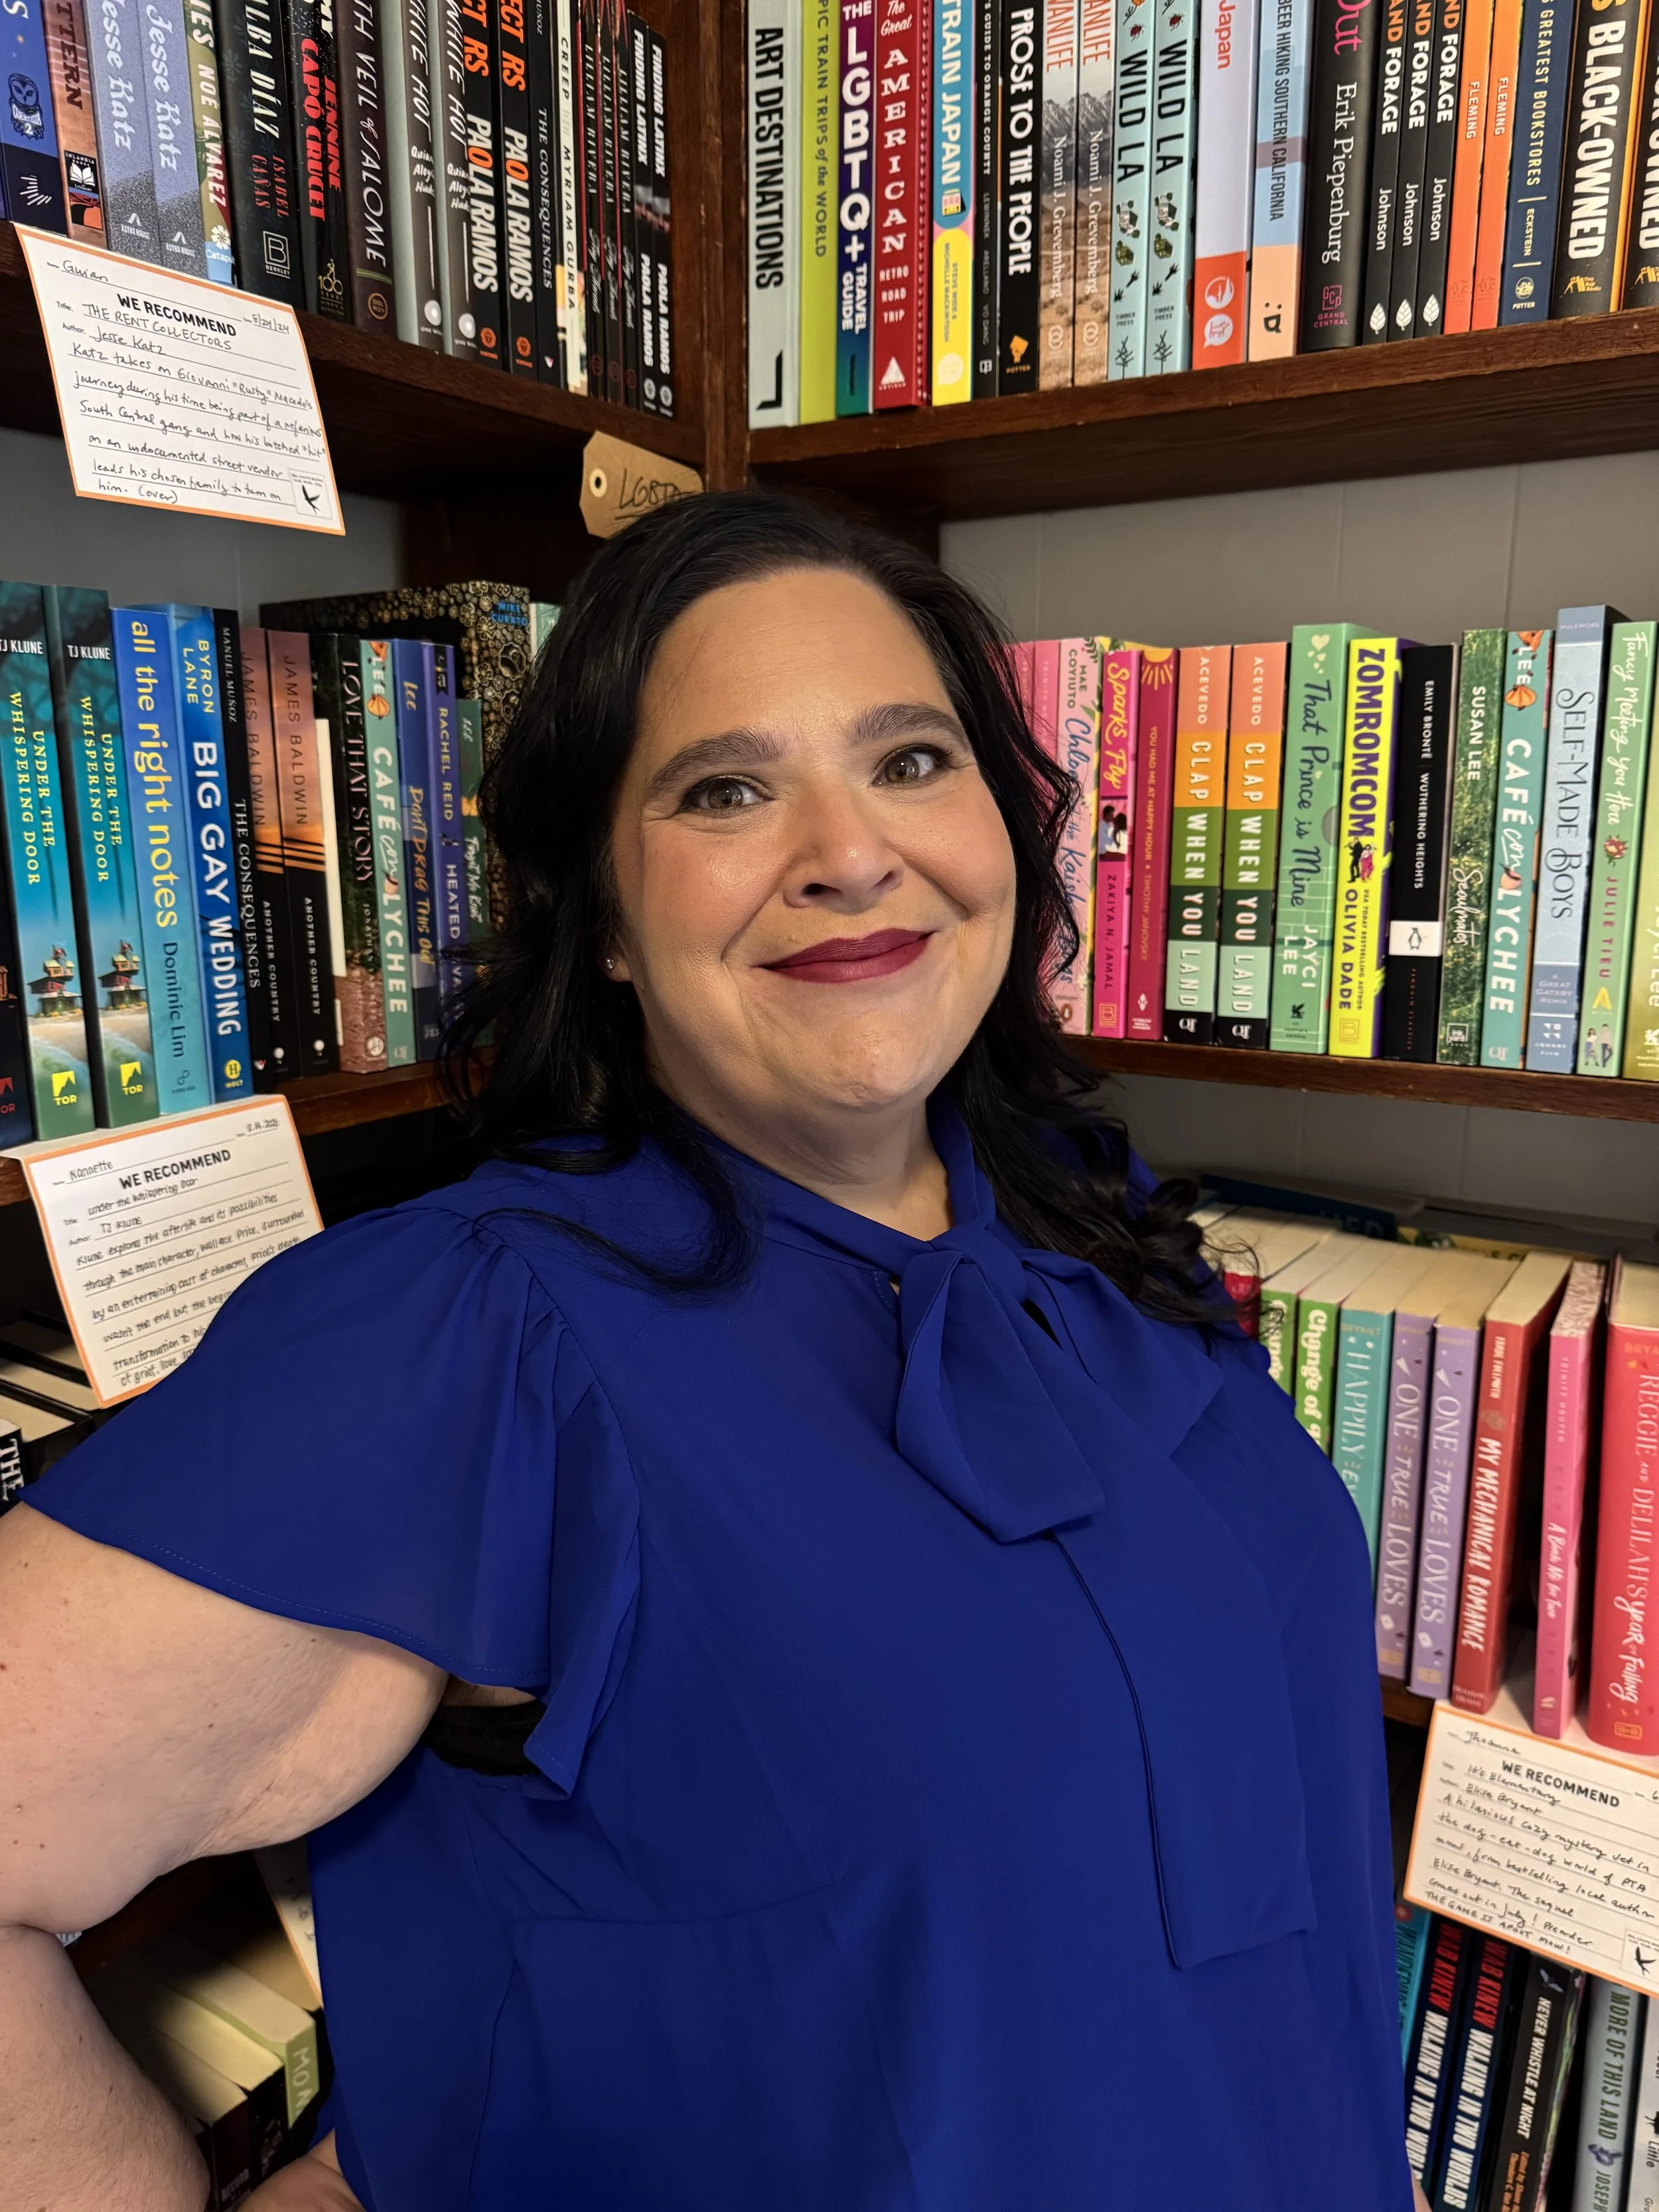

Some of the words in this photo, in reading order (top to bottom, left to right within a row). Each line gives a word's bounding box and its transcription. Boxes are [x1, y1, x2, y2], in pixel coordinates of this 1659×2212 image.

[842, 3, 872, 19] THE
[881, 15, 912, 37] Great
[146, 3, 173, 93] Jesse
[561, 37, 571, 100] CREEP
[634, 29, 645, 94] FINDING
[755, 27, 784, 80] ART
[814, 35, 829, 89] TRAIN
[941, 0, 962, 85] TRAIN
[983, 54, 991, 70] TO
[1010, 7, 1034, 96] PROSE
[1274, 35, 1291, 78] HIKING
[1536, 9, 1554, 85] GREATEST
[1116, 48, 1149, 129] WILD
[1273, 76, 1290, 144] SOUTHERN
[1334, 82, 1357, 131] Erik
[1382, 46, 1402, 135] FORAGE
[1465, 80, 1480, 140] FLEMING
[155, 100, 182, 172] Katz
[324, 75, 342, 192] JENNINE
[538, 108, 547, 145] THE
[635, 101, 648, 166] LATINX
[815, 94, 829, 145] TRIPS
[941, 92, 962, 185] JAPAN
[982, 119, 991, 177] COUNTY
[1010, 101, 1033, 140] TO
[1526, 90, 1548, 186] BOOKSTORES
[1567, 20, 1626, 259] BLACK-OWNED
[816, 165, 828, 186] the
[817, 149, 830, 162] of
[1009, 145, 1033, 186] THE
[1116, 141, 1145, 184] LA
[1269, 145, 1288, 222] CALIFORNIA
[273, 155, 289, 218] ISABEL
[563, 145, 574, 231] MYRIAM
[754, 86, 784, 291] DESTINATIONS
[1321, 137, 1354, 265] Piepenburg
[540, 148, 553, 289] CONSEQUENCES
[815, 192, 827, 259] WORLD
[1008, 193, 1033, 276] PEOPLE
[1376, 187, 1392, 252] Johnson
[1524, 207, 1535, 256] ECKSTEIN
[265, 264, 291, 278] BERKLEY
[566, 242, 576, 309] GURBA
[855, 263, 867, 335] TRAVEL
[879, 265, 909, 282] RETRO
[881, 288, 906, 302] ROAD
[56, 301, 74, 311] Title:
[82, 303, 109, 319] THE
[115, 311, 149, 329] RENT
[153, 321, 232, 350] COLLECTORS
[117, 293, 141, 311] WE
[147, 302, 237, 336] RECOMMEND
[841, 271, 856, 331] GUIDE
[883, 309, 905, 324] TRIP
[1313, 319, 1348, 329] CENTRAL
[1318, 311, 1345, 321] GRAND
[11, 640, 44, 655] KLUNE
[67, 645, 80, 657] TJ
[80, 646, 110, 660] KLUNE
[131, 621, 156, 654] all
[222, 626, 234, 677] MANUEL
[1613, 632, 1648, 682] Fancy
[135, 665, 159, 711] the
[182, 647, 199, 705] LANE
[197, 639, 215, 713] BYRON
[226, 680, 238, 723] MUÑOZ
[242, 652, 258, 721] JAMES
[1068, 648, 1077, 710] COYIUTO
[1079, 664, 1088, 692] MAE
[1104, 662, 1131, 745] Sparks
[1198, 657, 1211, 725] ACEVEDO
[1304, 679, 1332, 732] That
[1424, 680, 1435, 707] EMILY
[438, 707, 451, 774] RACHEL
[1348, 648, 1386, 838] ZOMROMCOM
[1469, 686, 1486, 746] SUSAN
[1610, 687, 1644, 755] Meeting
[9, 691, 33, 823] WHISPERING
[23, 831, 40, 885] DOOR
[32, 730, 50, 798] UNDER
[135, 723, 173, 814] right
[192, 741, 222, 810] BIG
[247, 733, 266, 826] BALDWIN
[373, 747, 401, 831] CAFÉ
[1103, 749, 1126, 790] Fly
[1189, 741, 1212, 800] CLAP
[1297, 745, 1329, 811] Prince
[1467, 753, 1481, 782] LEE
[1555, 688, 1595, 838] SELF-MADE
[1607, 757, 1631, 787] You
[40, 806, 55, 848] THE
[441, 782, 453, 821] REID
[1295, 816, 1310, 840] is
[1415, 772, 1429, 841] WUTHERING
[1606, 792, 1633, 825] Here
[201, 823, 231, 904] GAY
[1185, 813, 1206, 879] WHEN
[1414, 843, 1424, 890] HEIGHTS
[148, 824, 180, 928] notes
[445, 864, 460, 940] HEATED
[1291, 846, 1322, 907] Mine
[1545, 847, 1582, 920] BOYS
[1602, 877, 1618, 928] JULIE
[264, 900, 276, 960] ANOTHER
[1181, 891, 1204, 936] YOU
[1340, 889, 1358, 956] OLIVIA
[1450, 868, 1483, 947] Seoulmates
[163, 942, 182, 1021] Dominic
[209, 915, 242, 1037] WEDDING
[382, 895, 408, 1013] LYCHEE
[1178, 948, 1200, 1007] LAND
[1283, 936, 1297, 976] LEE
[1302, 924, 1319, 988] JAYCI
[1598, 938, 1613, 979] TIEU
[267, 964, 280, 1023] COUNTRY
[1338, 962, 1354, 1010] DADE
[170, 1025, 186, 1058] Lim
[54, 1095, 77, 1106] TOR
[123, 1084, 143, 1095] TOR
[119, 1175, 141, 1189] WE
[143, 1149, 232, 1183] RECOMMEND
[1301, 1309, 1327, 1391] Change
[1303, 1395, 1322, 1420] of
[1392, 1382, 1421, 1439] ONE
[1478, 1436, 1502, 1469] MY
[1390, 1457, 1412, 1516] TRUE
[1467, 1471, 1500, 1570] MECHANICAL
[1381, 1523, 1412, 1609] LOVES
[1461, 1572, 1492, 1653] ROMANCE
[1502, 1759, 1522, 1776] WE
[1526, 1768, 1620, 1808] RECOMMEND
[1534, 1996, 1551, 2033] NEVER
[1609, 1991, 1631, 2036] MORE
[1417, 2010, 1449, 2079] WALKING
[1461, 2028, 1493, 2098] WALKING
[1526, 2035, 1546, 2087] WHISTLE
[1607, 2037, 1625, 2059] OF
[1413, 2075, 1437, 2099] IN
[1523, 2085, 1538, 2102] AT
[1602, 2055, 1624, 2096] THIS
[1409, 2095, 1436, 2130] TWO
[1453, 2115, 1480, 2150] TWO
[1457, 2095, 1482, 2118] IN
[1518, 2099, 1536, 2140] NIGHT
[1598, 2098, 1620, 2140] LAND
[1443, 2148, 1475, 2209] WORLDS
